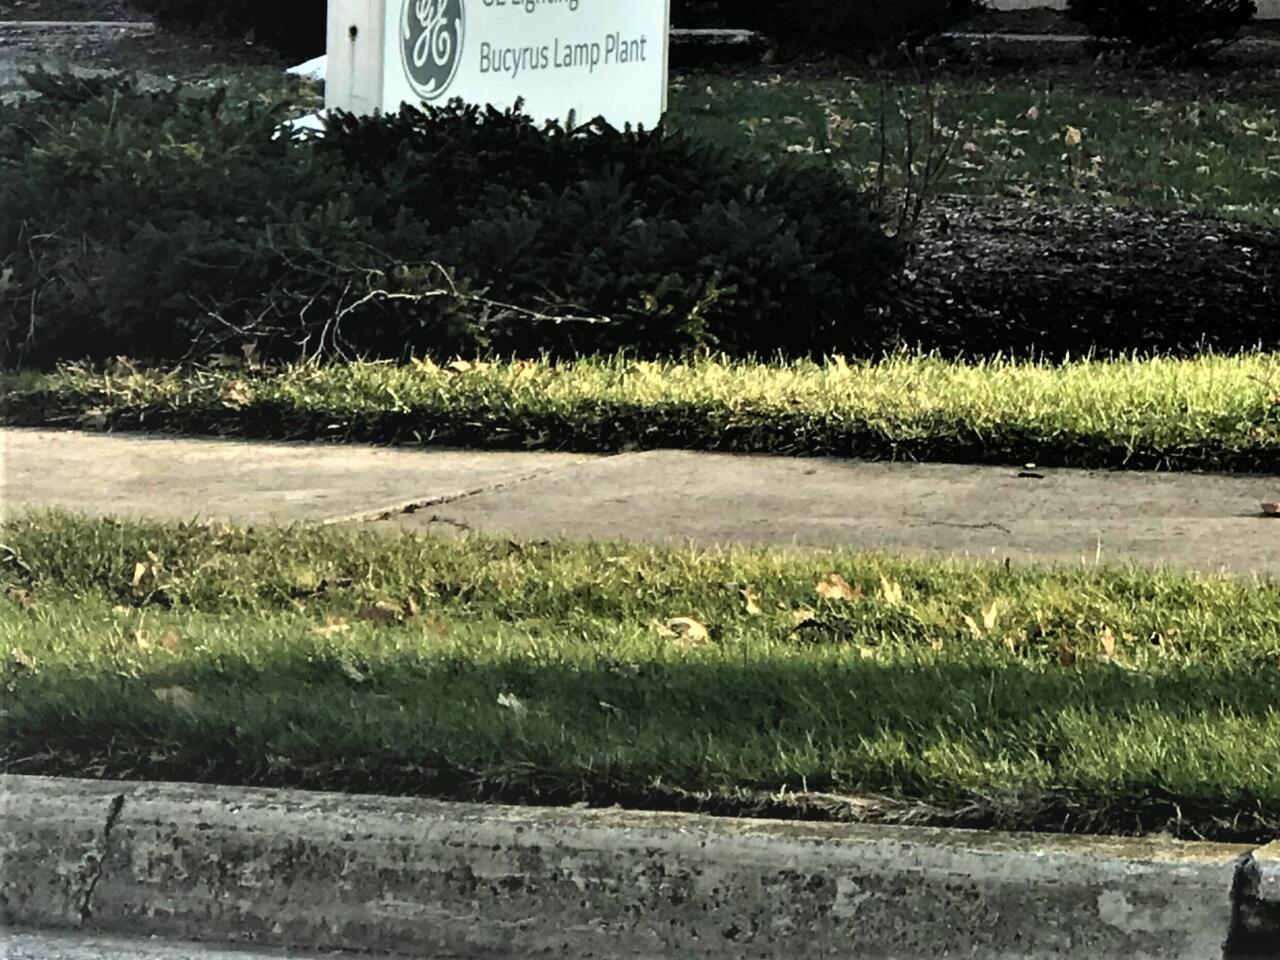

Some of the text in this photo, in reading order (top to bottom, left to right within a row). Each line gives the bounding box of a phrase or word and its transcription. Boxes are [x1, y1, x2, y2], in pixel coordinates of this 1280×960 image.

[479, 31, 647, 79] Bucyrus Lamp Plant
